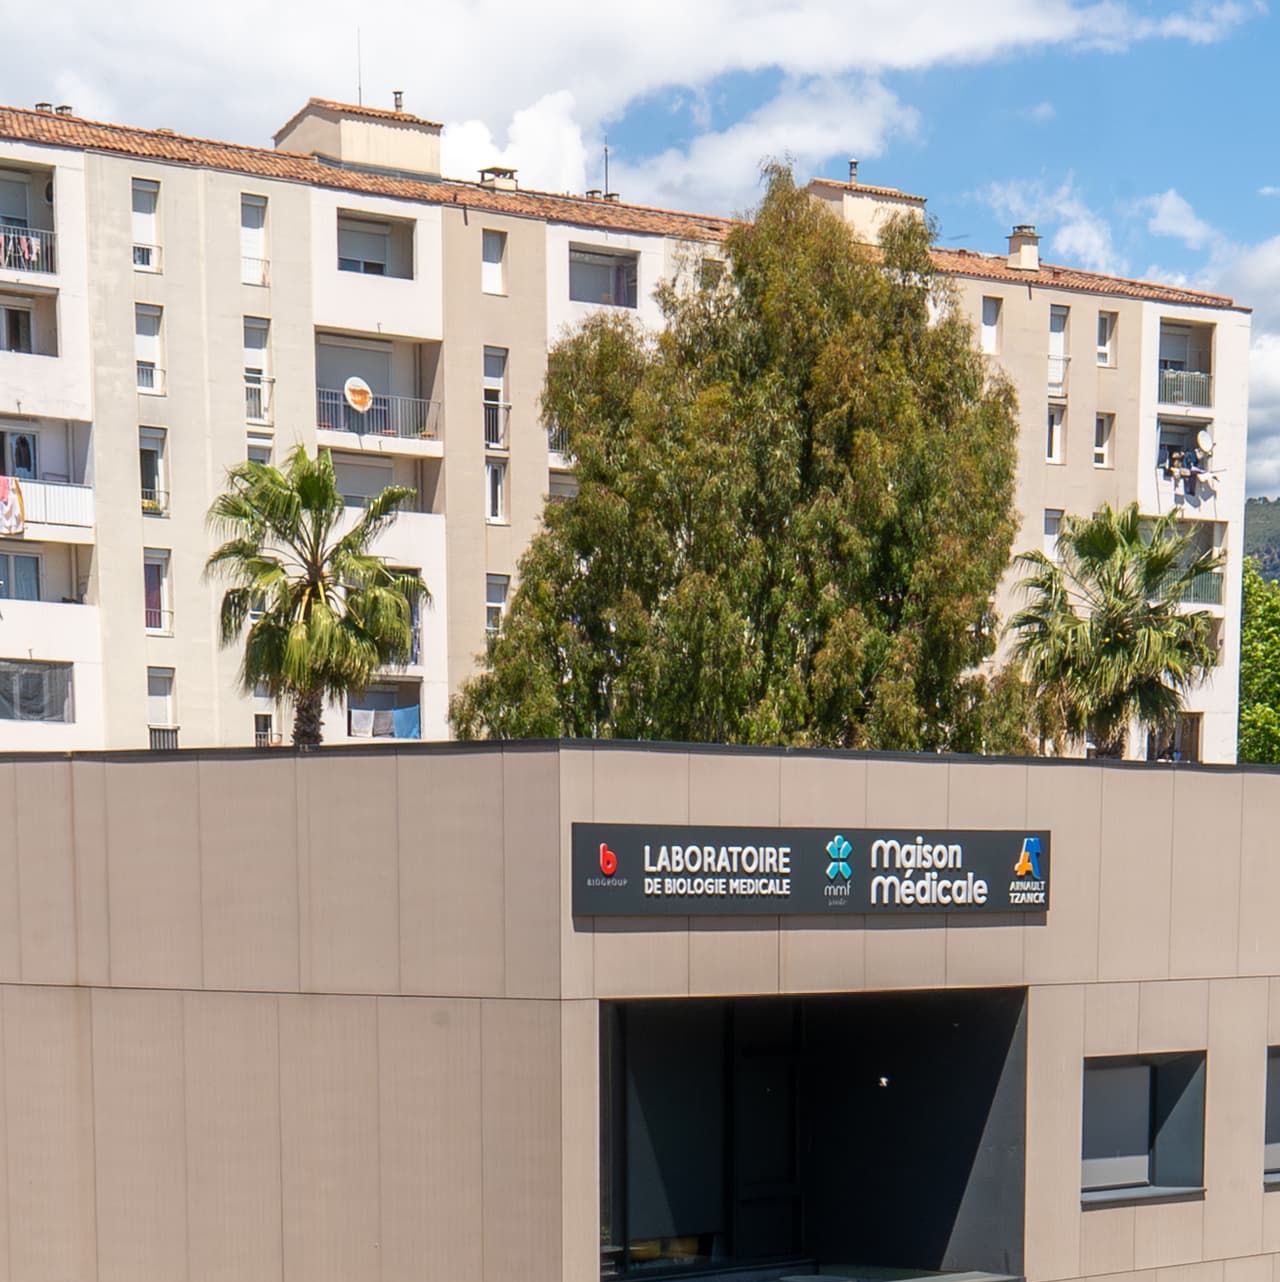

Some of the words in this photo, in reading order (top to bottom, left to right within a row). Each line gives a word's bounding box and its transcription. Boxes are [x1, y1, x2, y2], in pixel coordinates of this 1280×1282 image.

[644, 845, 791, 873] LABORATOIRE
[587, 878, 628, 887] BIOGROUP
[644, 878, 662, 895] DE
[664, 878, 726, 895] BIOLOGIE
[730, 879, 791, 896] MEDICALE
[824, 881, 851, 896] mmf
[1009, 880, 1046, 891] ARNAULT
[1009, 892, 1046, 904] TZANCK
